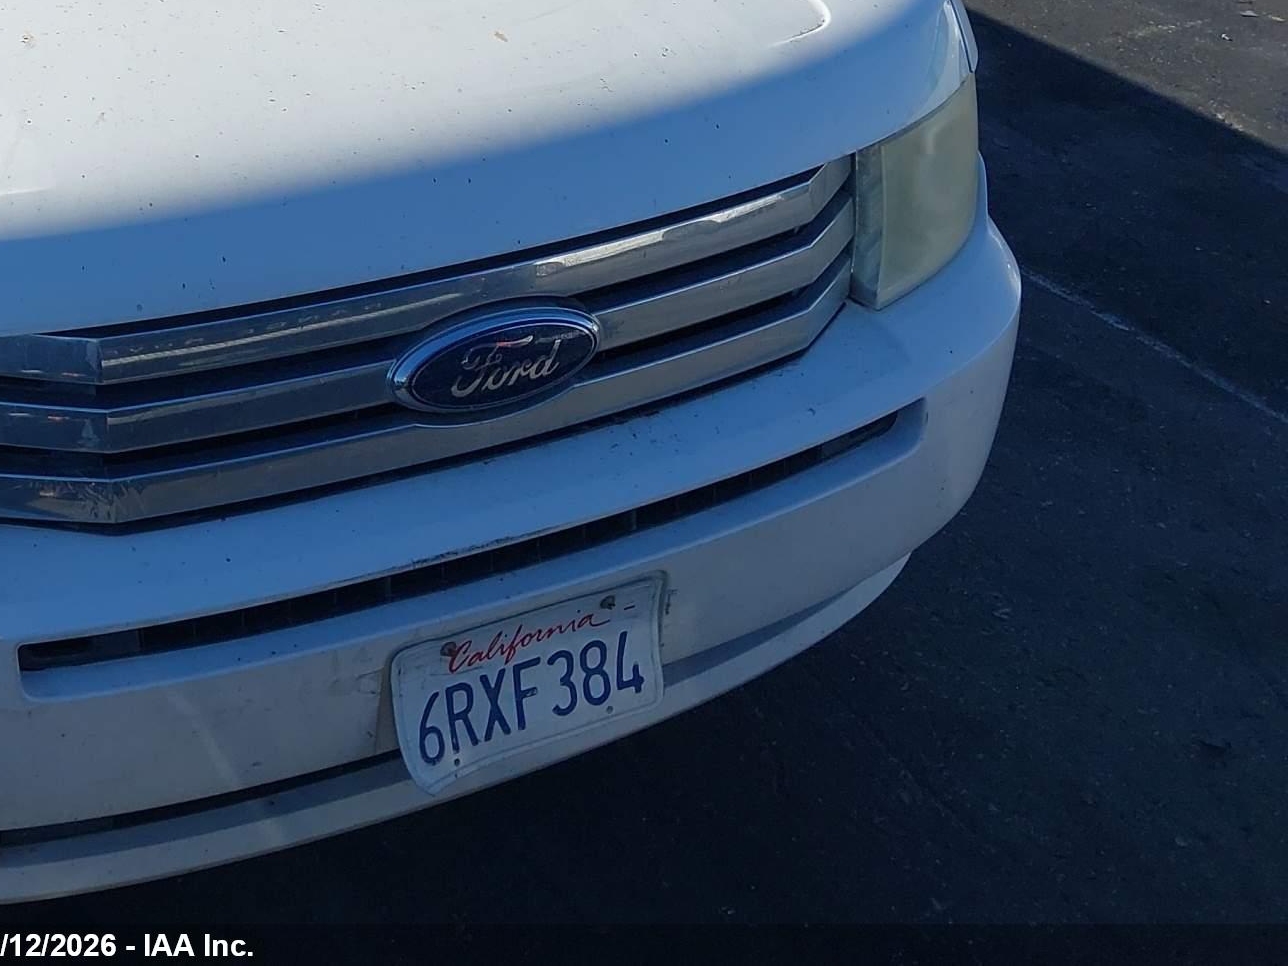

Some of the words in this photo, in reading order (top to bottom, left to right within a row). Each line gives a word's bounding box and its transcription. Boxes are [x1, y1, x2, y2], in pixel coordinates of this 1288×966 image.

[451, 335, 562, 398] Ford
[448, 610, 611, 674] California
[419, 631, 645, 766] 6RXF384
